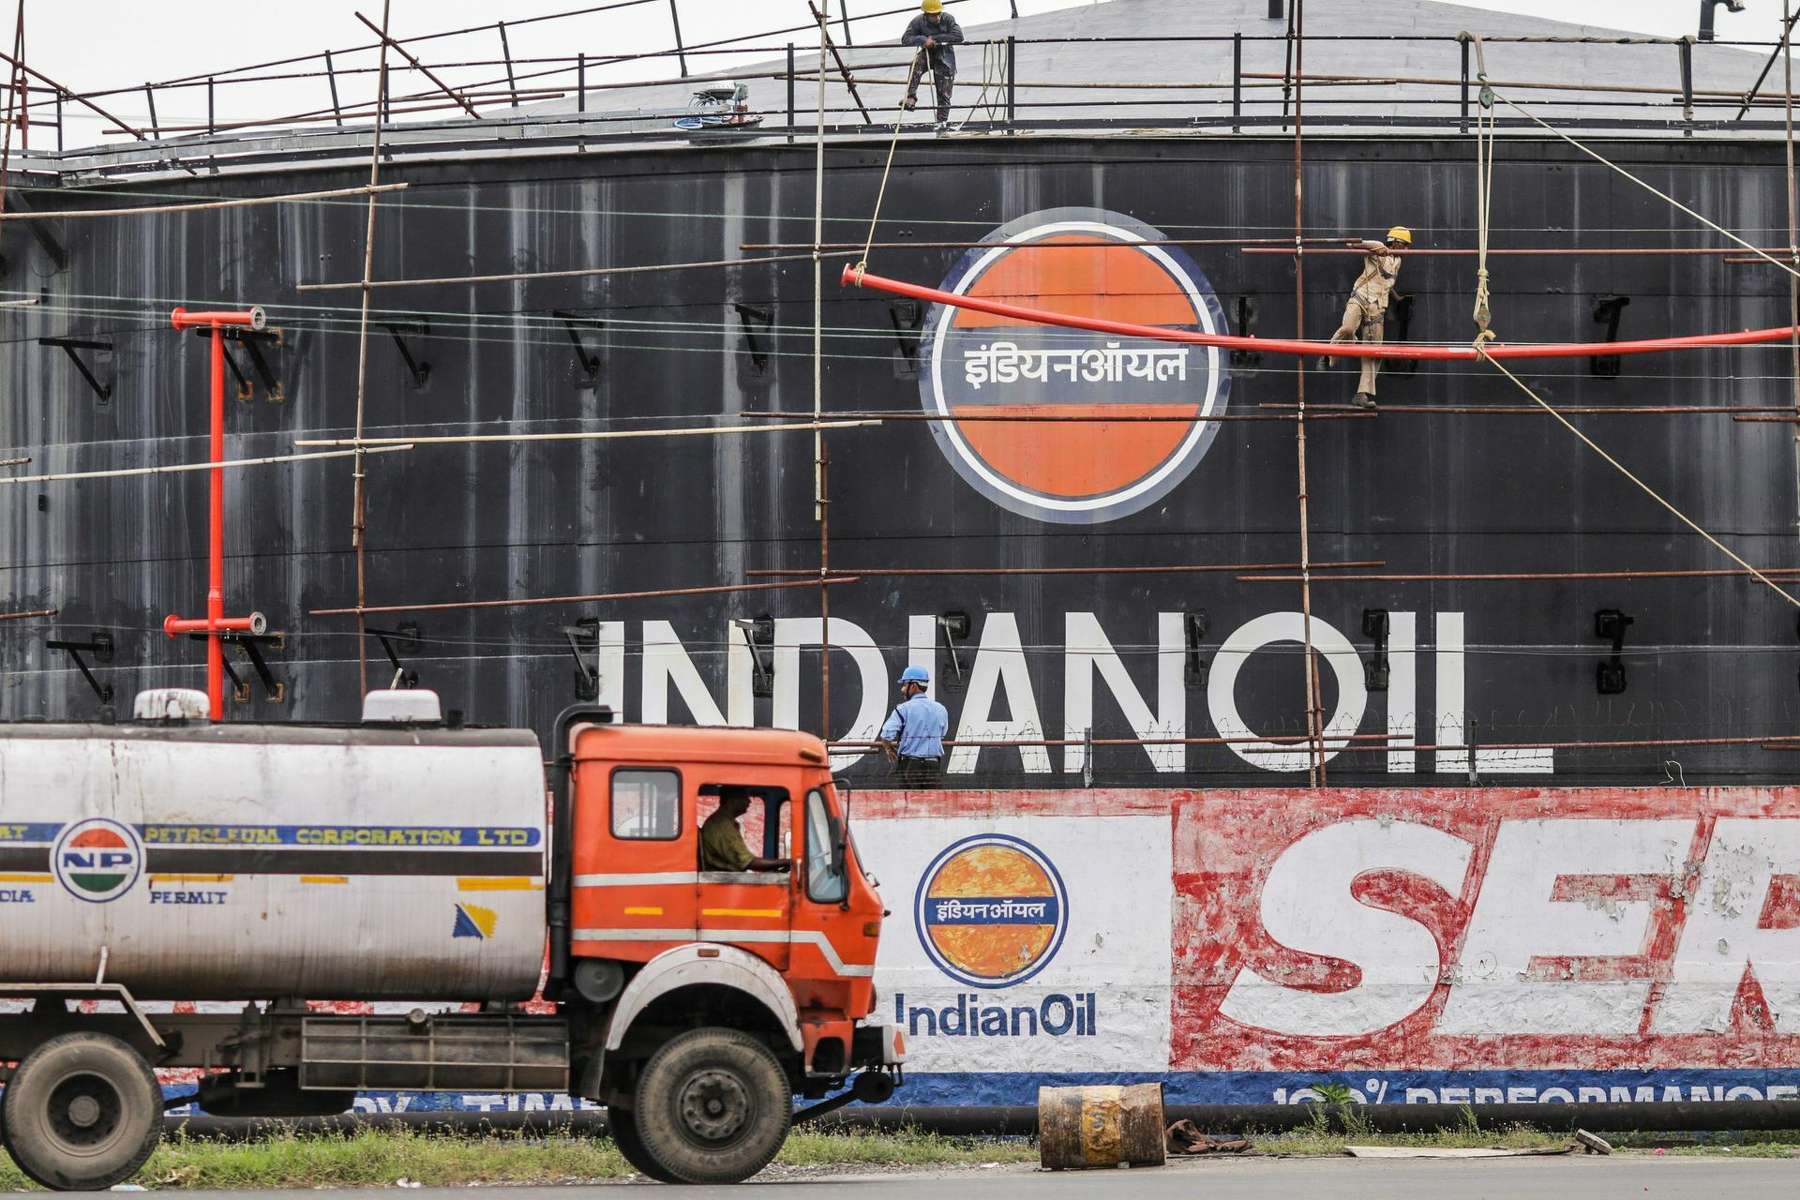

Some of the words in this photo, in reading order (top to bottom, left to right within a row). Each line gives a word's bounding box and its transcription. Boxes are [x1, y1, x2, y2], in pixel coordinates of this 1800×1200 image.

[145, 827, 282, 844] PETROLEUM
[297, 829, 461, 845] CORPORATION
[478, 829, 528, 845] LTD
[63, 853, 133, 868] NP
[150, 891, 228, 904] PERMIT
[895, 993, 1096, 1037] IndianOil
